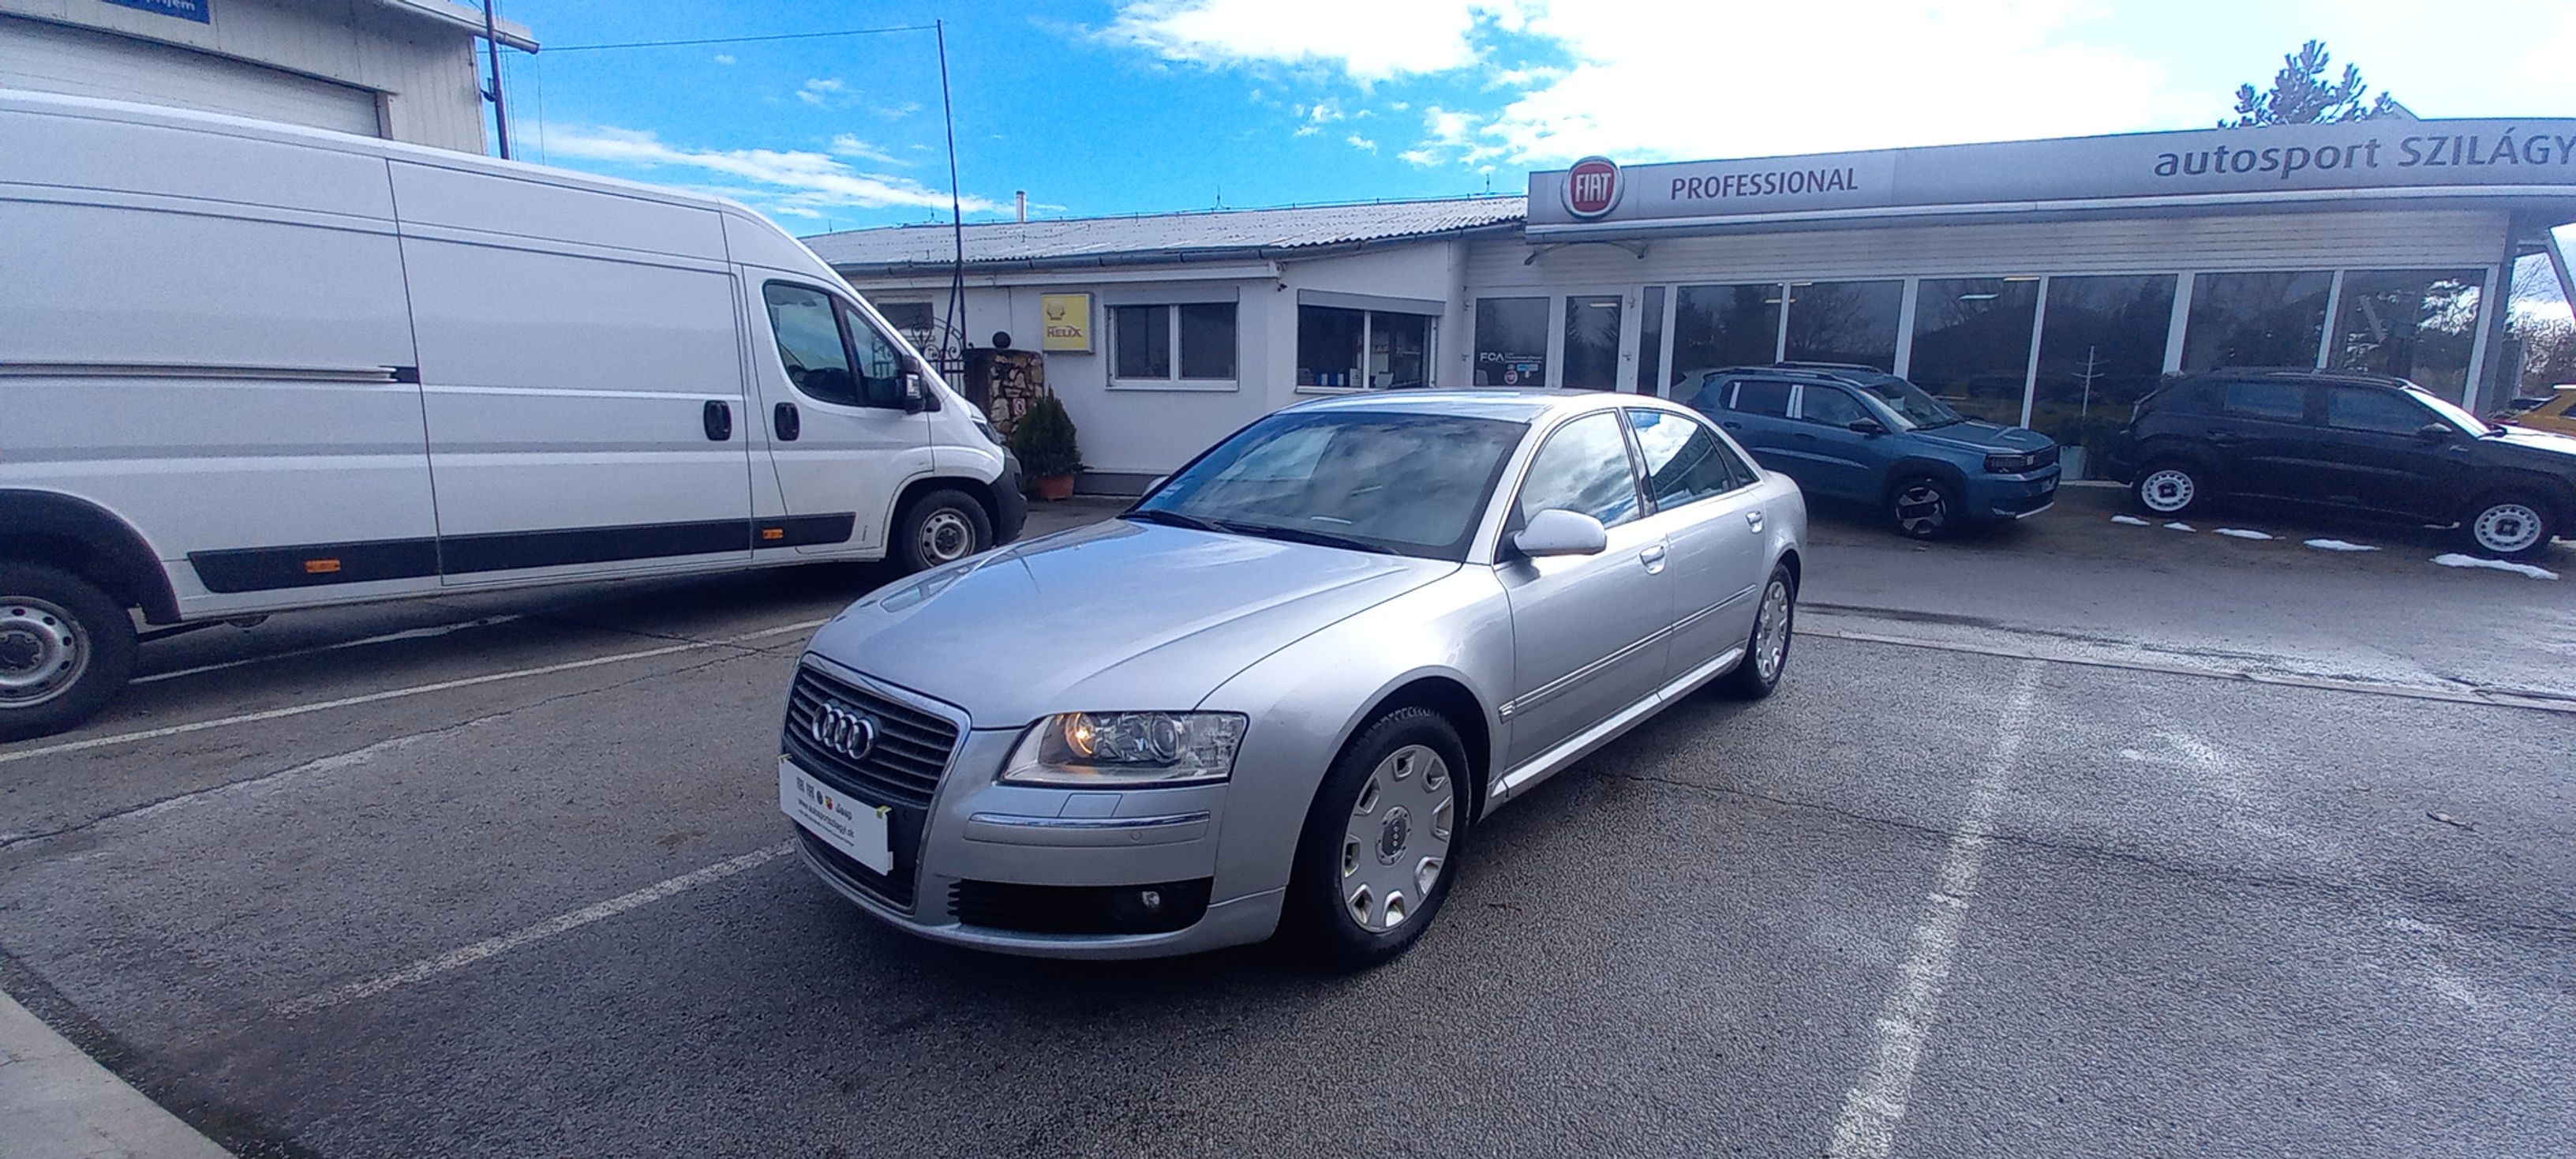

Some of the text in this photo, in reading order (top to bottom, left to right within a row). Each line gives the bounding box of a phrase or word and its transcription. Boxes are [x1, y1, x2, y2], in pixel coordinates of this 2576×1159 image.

[2154, 138, 2380, 180] autosport
[1575, 172, 1612, 202] FIAT
[1671, 167, 1858, 200] PROFESSIONAL
[1046, 325, 1083, 338] HELIX
[1480, 352, 1504, 362] FCA
